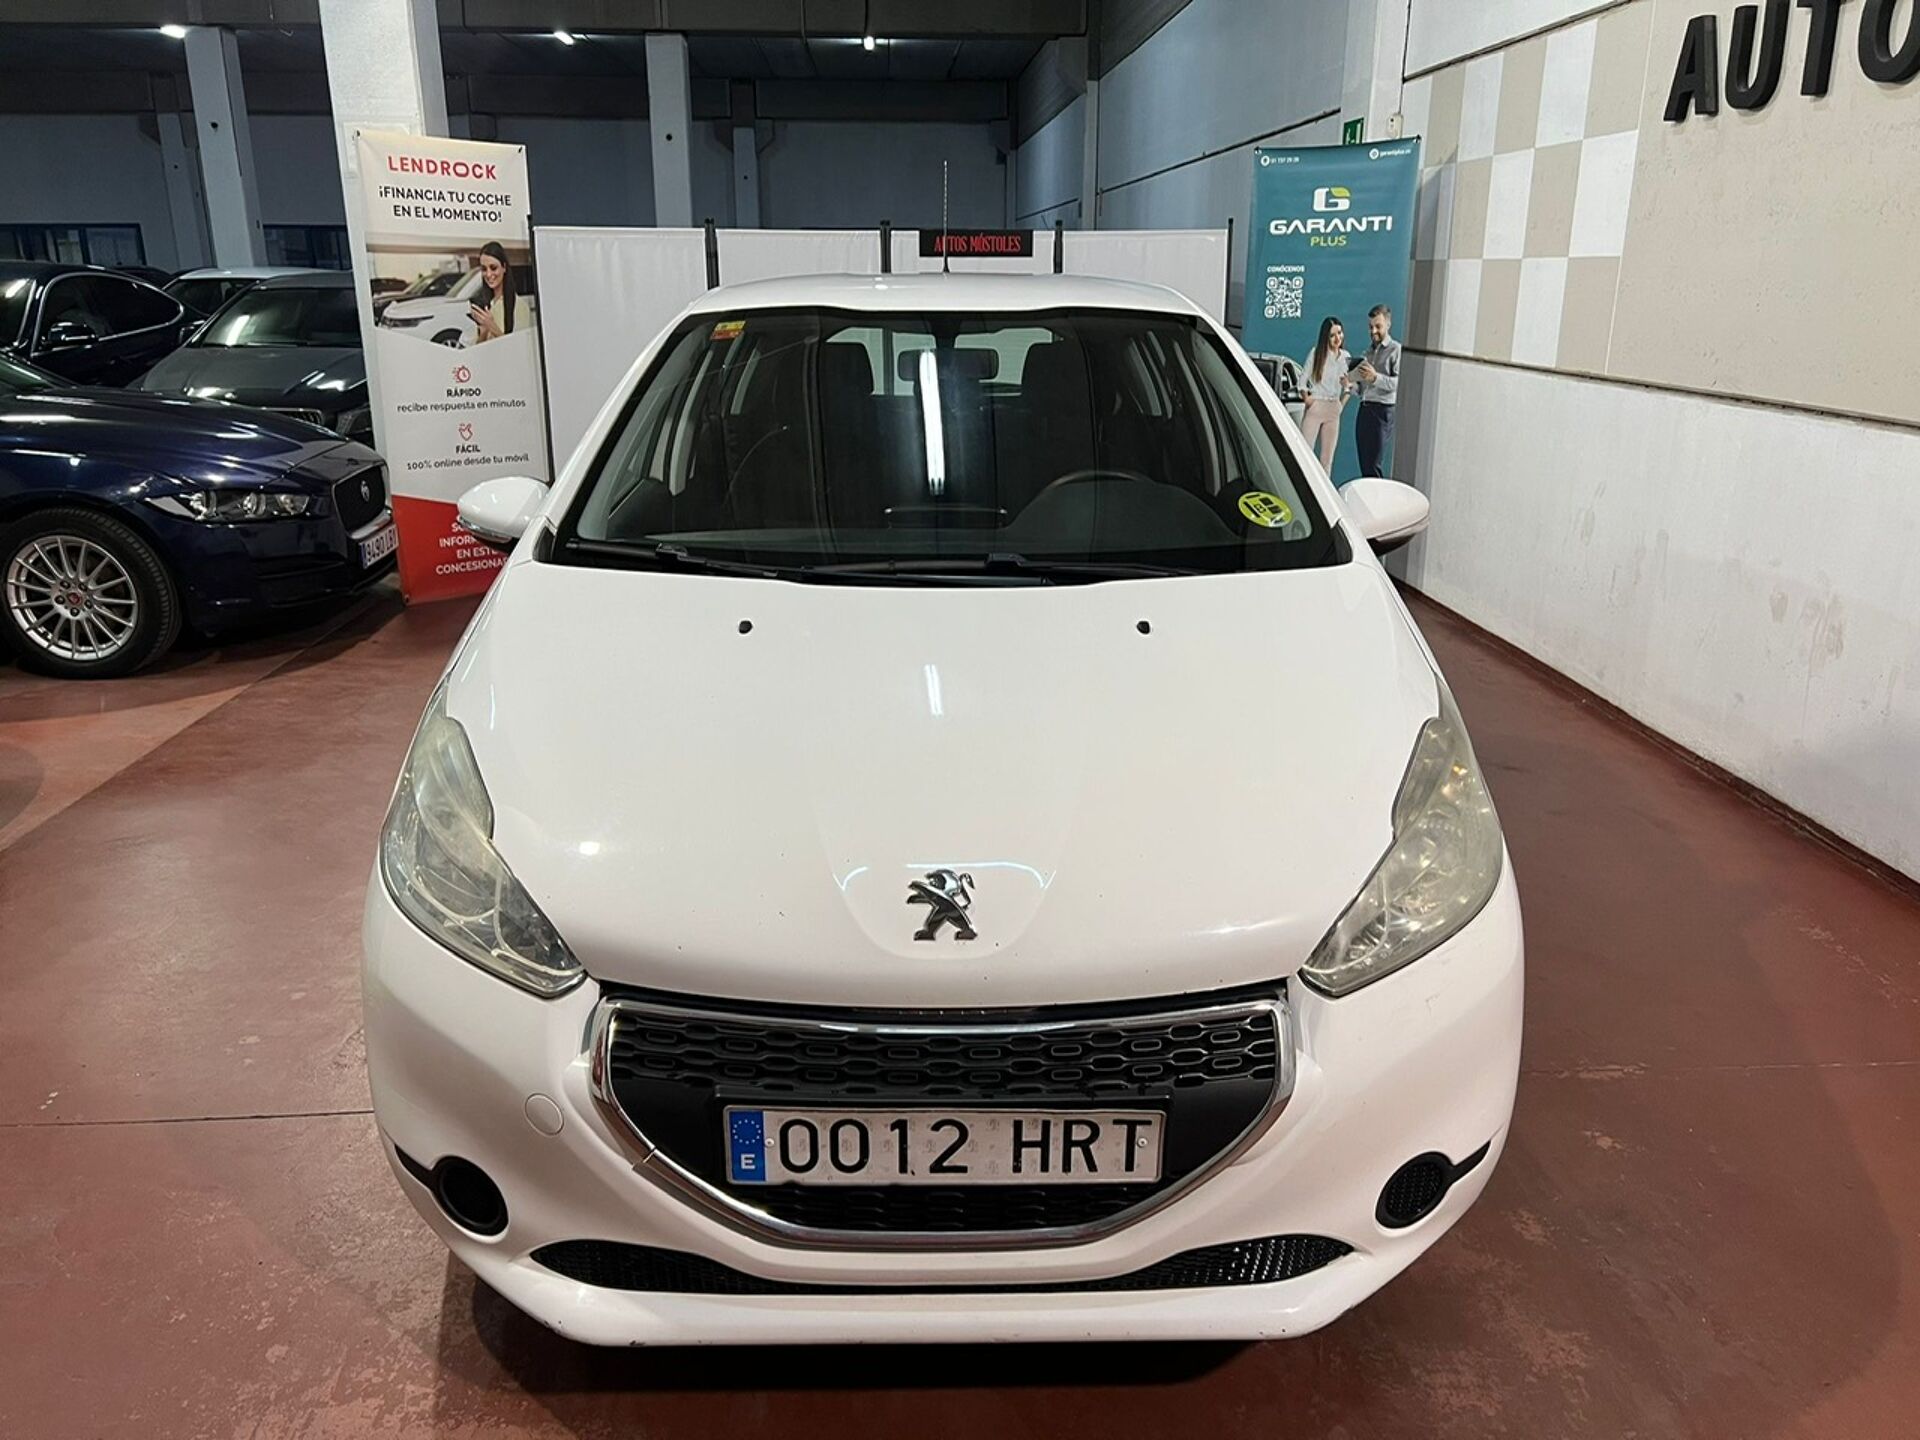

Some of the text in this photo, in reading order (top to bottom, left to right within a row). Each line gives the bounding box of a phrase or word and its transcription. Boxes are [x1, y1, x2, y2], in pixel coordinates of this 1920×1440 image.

[388, 156, 496, 180] LENDROCK
[378, 185, 512, 207] ¡FINANCIA TU COCHE
[393, 205, 502, 223] EN EL MOMENTO!
[1269, 215, 1393, 235] GARANTI
[934, 232, 1022, 252] AUTOS MÓSTOLES
[1310, 235, 1347, 247] PLUS
[1267, 264, 1306, 274] CONÓCENOS
[446, 387, 481, 398] RÁPIDO
[397, 399, 526, 413] recibe respuesta en minutos
[455, 444, 481, 454] FÁCIL
[407, 453, 529, 470] 100% online desde tu móvil
[456, 548, 471, 559] EN
[740, 1117, 1153, 1175] E 0012 HRT
